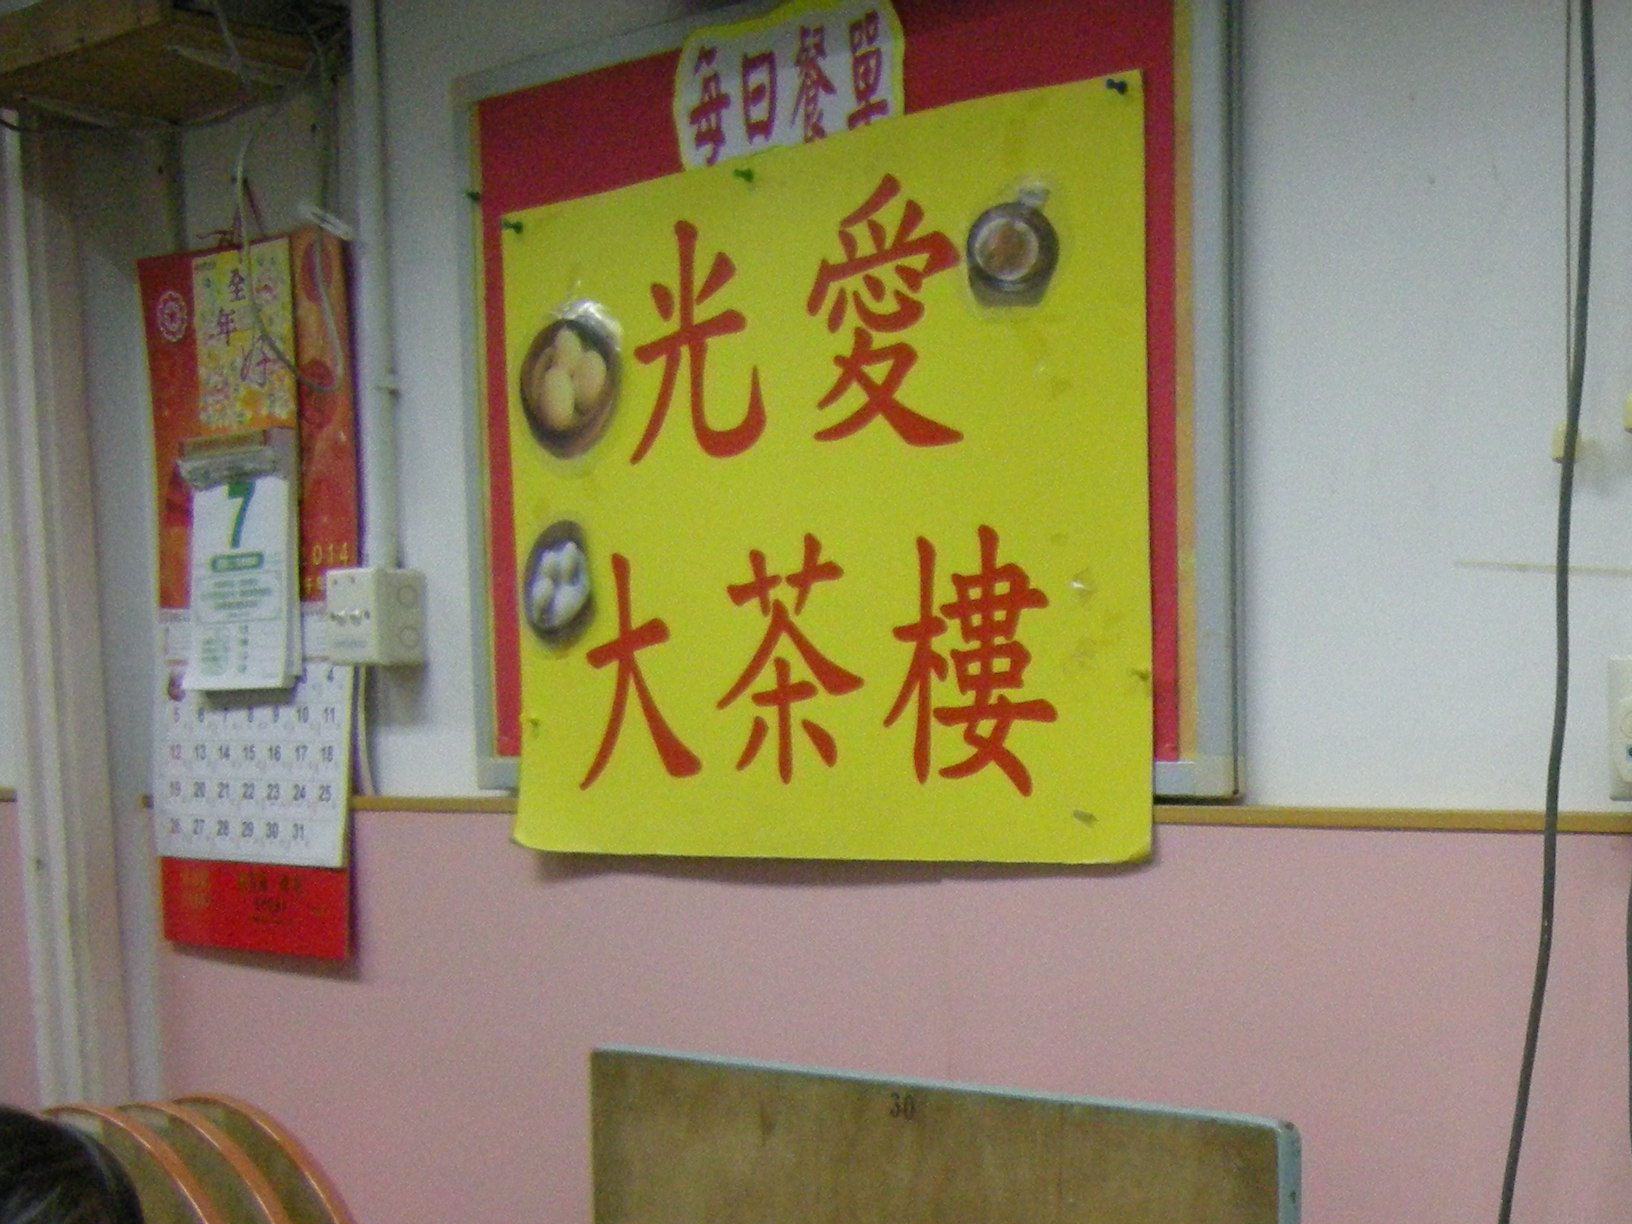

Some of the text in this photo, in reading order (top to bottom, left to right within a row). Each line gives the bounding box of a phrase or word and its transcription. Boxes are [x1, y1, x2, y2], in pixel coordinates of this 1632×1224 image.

[689, 9, 889, 166] 每日餐單
[631, 174, 964, 466] 光愛
[227, 479, 256, 549] 7
[579, 524, 1059, 798] 大茶樓
